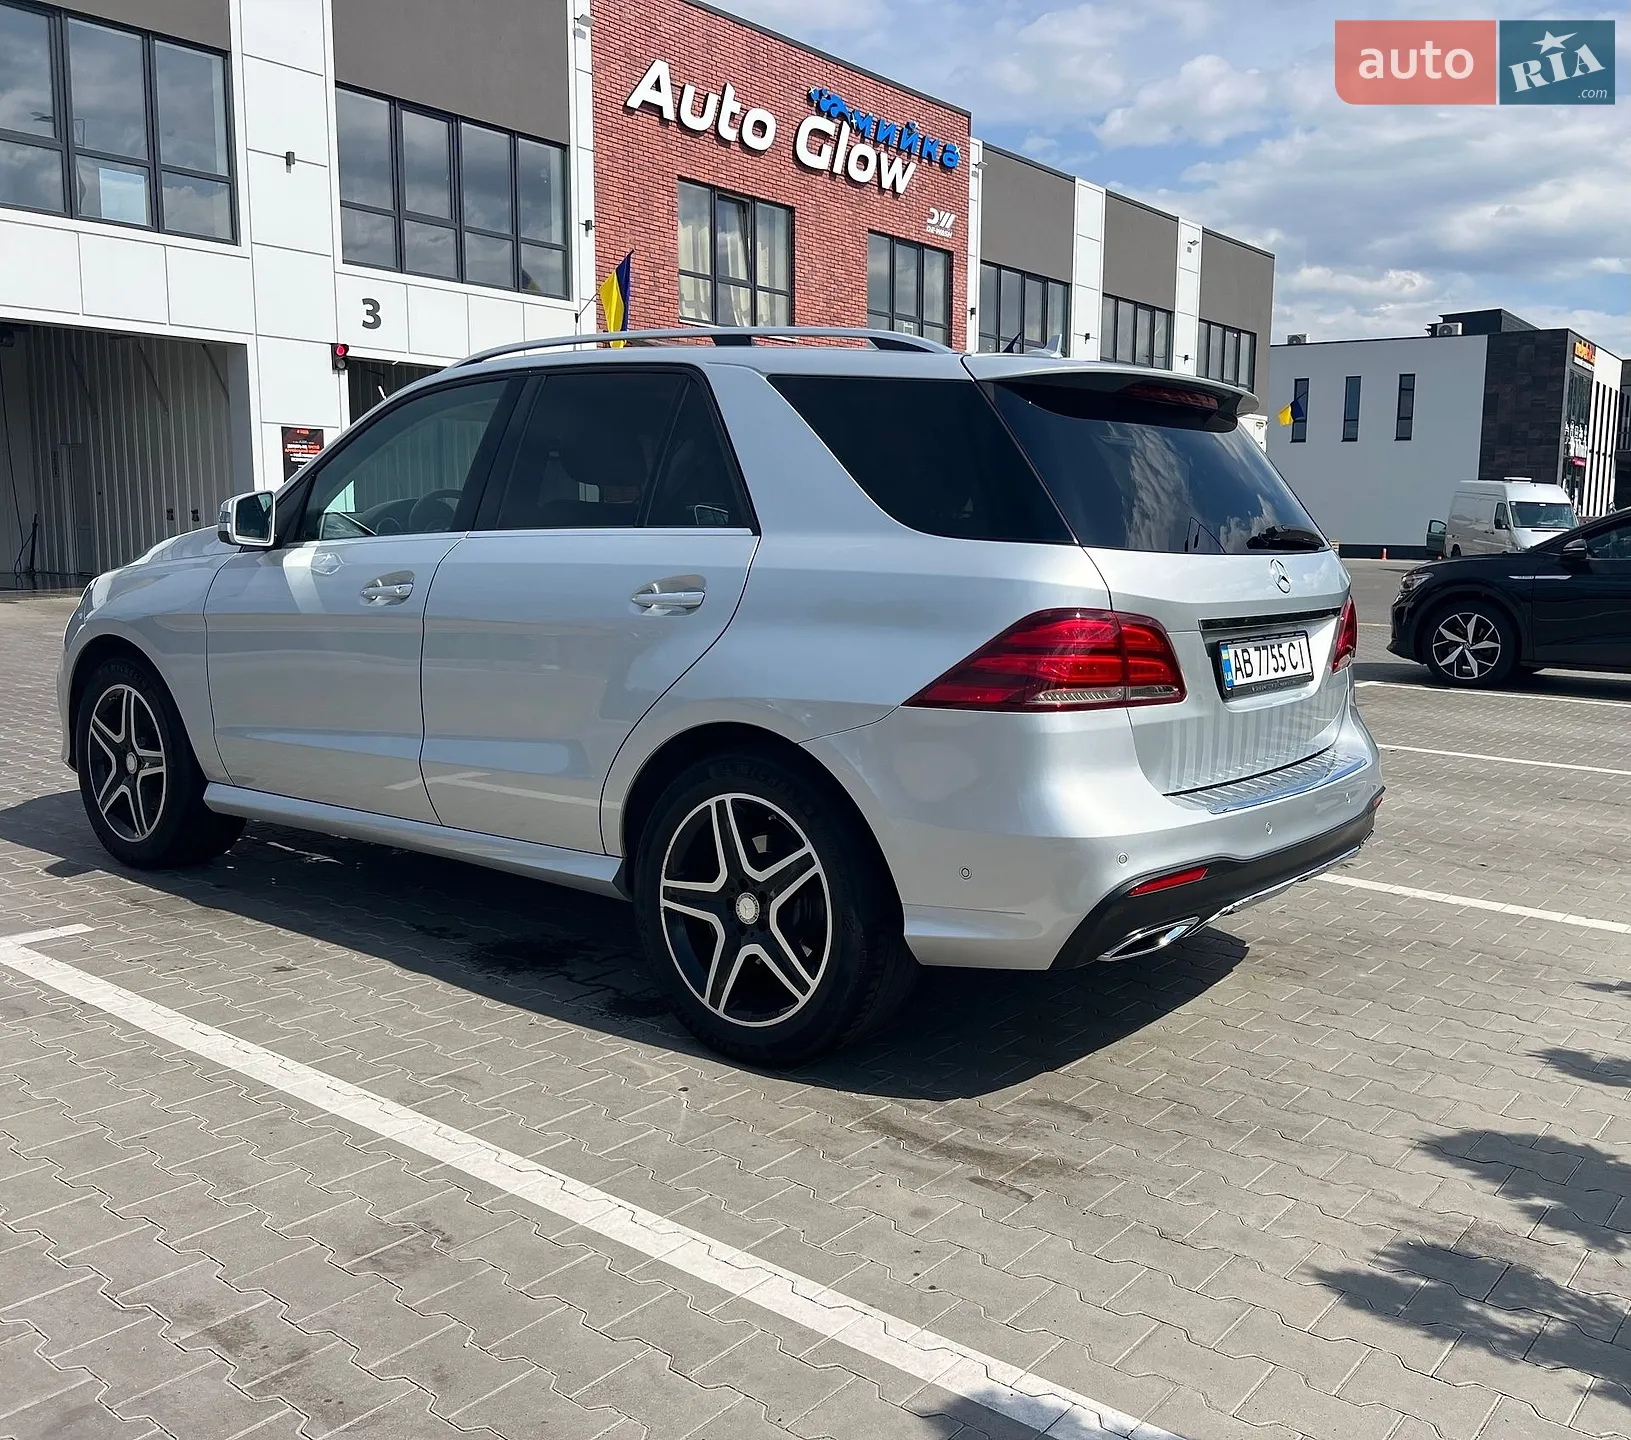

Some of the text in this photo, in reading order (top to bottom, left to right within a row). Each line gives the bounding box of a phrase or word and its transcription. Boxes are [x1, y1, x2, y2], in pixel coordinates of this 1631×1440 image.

[626, 59, 917, 195] Auto Glow
[361, 298, 382, 330] 3
[1233, 641, 1305, 680] AB 7755 CI
